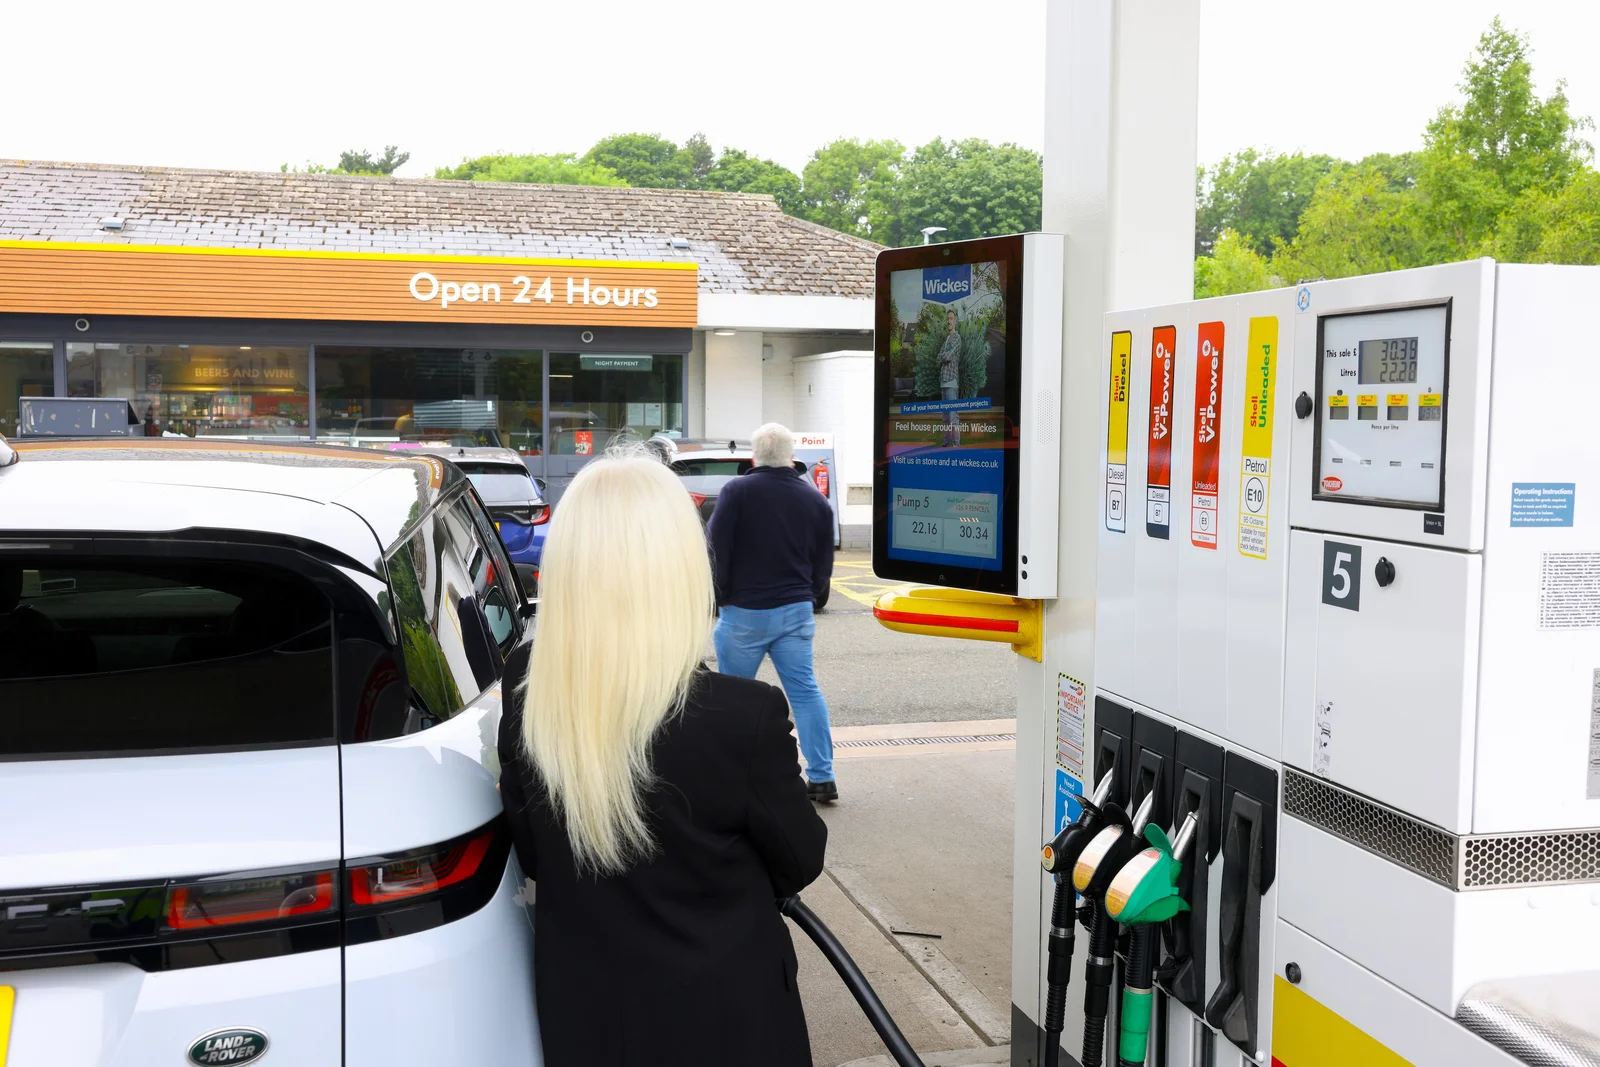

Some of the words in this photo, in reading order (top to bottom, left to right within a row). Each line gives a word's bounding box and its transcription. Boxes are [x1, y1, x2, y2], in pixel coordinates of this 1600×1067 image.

[409, 272, 501, 308] Open
[512, 276, 554, 304] 24
[566, 277, 659, 307] Hours
[925, 278, 968, 294] Wickes
[1326, 349, 1337, 358] This
[1339, 348, 1351, 357] sale
[1353, 347, 1357, 357] £
[1380, 339, 1418, 361] 30.38
[195, 367, 229, 378] BEERS
[232, 368, 260, 378] AND
[263, 368, 295, 379] WINE
[1340, 368, 1357, 377] Litres
[1258, 344, 1271, 428] Unleaded
[1159, 348, 1171, 440] V-Power
[1206, 346, 1219, 443] V-Power
[917, 404, 926, 412] your
[940, 401, 969, 410] improvement
[970, 400, 989, 408] projects
[1250, 396, 1258, 427] Shell
[895, 422, 909, 431] Feel
[911, 422, 931, 431] house
[932, 422, 953, 433] proud
[954, 422, 969, 432] with
[970, 423, 997, 433] Wickes
[801, 436, 826, 445] Point
[893, 456, 906, 464] Visit
[915, 457, 921, 465] in
[922, 458, 938, 466] store
[939, 458, 950, 466] and
[951, 459, 958, 467] at
[958, 459, 999, 468] wickes.co.uk
[1245, 458, 1268, 473] Petrol
[1108, 467, 1124, 480] Diesel
[1194, 480, 1217, 491] Unleaded
[1514, 488, 1541, 496] Operating
[1152, 490, 1164, 499] Diesel
[1198, 496, 1211, 506] Petrol
[1247, 488, 1262, 503] E10
[897, 494, 920, 511] Pump
[923, 496, 930, 509] 5
[969, 505, 990, 513] PENCE/L
[1112, 499, 1120, 511] B7
[1201, 516, 1207, 525] E5
[1250, 516, 1264, 526] Octane
[912, 521, 938, 535] 22.16
[959, 525, 989, 540] 30.34
[1331, 551, 1352, 599] 5
[1060, 690, 1084, 707] IMPORTANT
[1063, 700, 1079, 714] NOTICE
[1063, 777, 1075, 791] Need
[1059, 784, 1078, 802] Assistanc
[204, 1035, 244, 1052] LAND
[207, 1045, 256, 1063] ROVER
